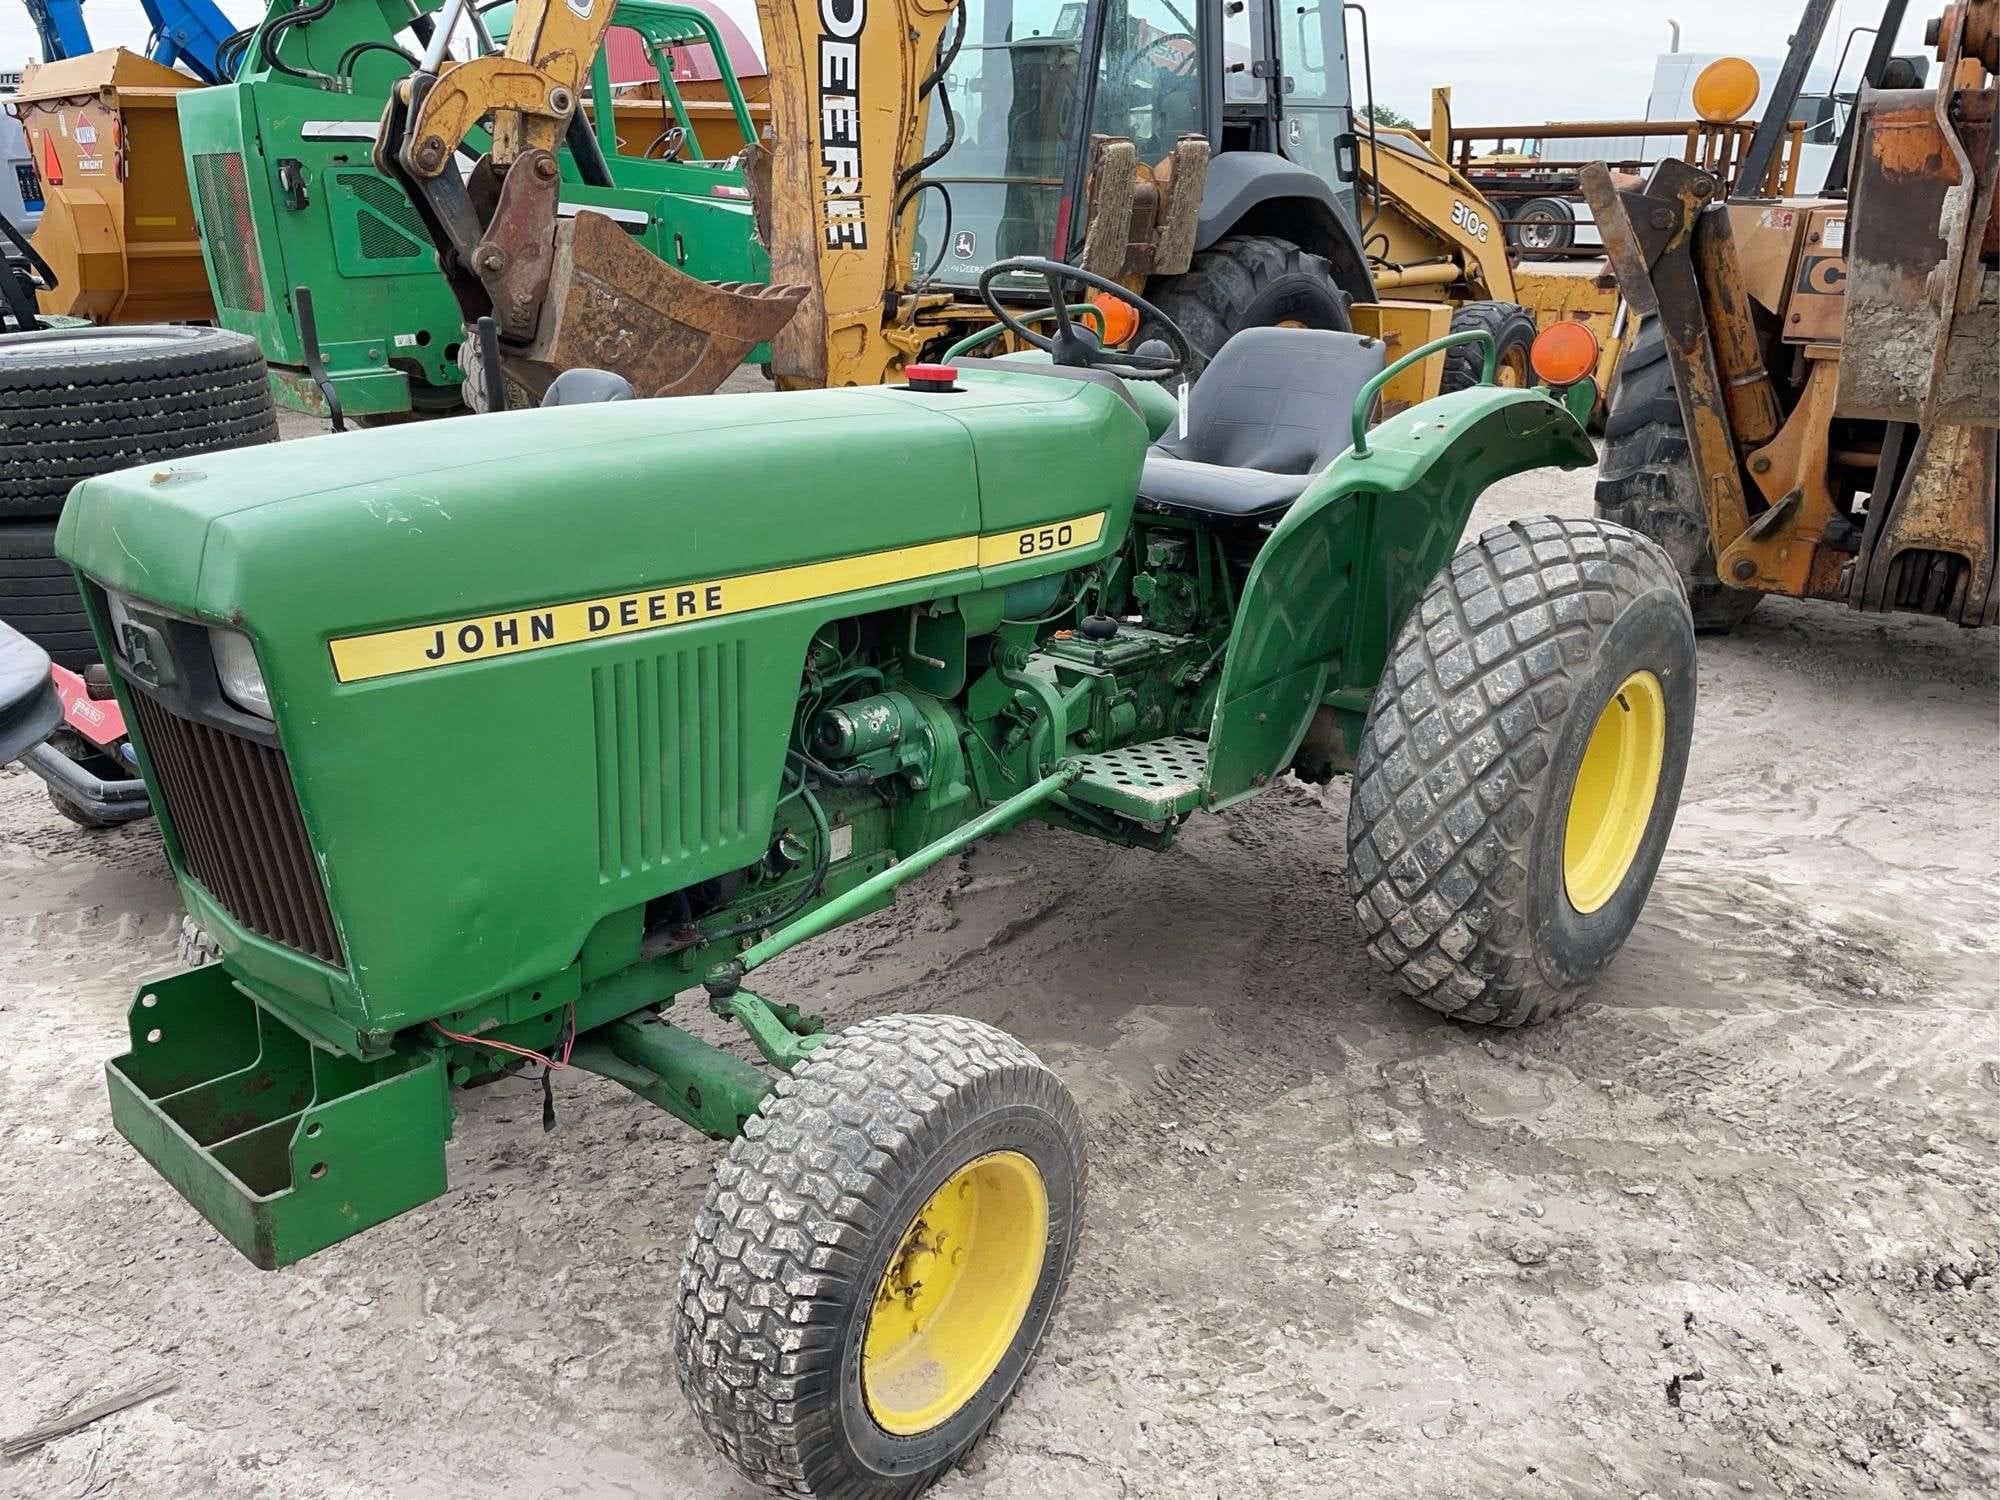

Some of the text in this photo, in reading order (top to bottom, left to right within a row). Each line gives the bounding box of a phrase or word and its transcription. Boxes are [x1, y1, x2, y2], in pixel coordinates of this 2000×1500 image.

[79, 160, 103, 170] KNIGHT
[1451, 199, 1488, 243] 310G
[1019, 525, 1072, 555] 850
[425, 585, 723, 660] JOHN DEERE
